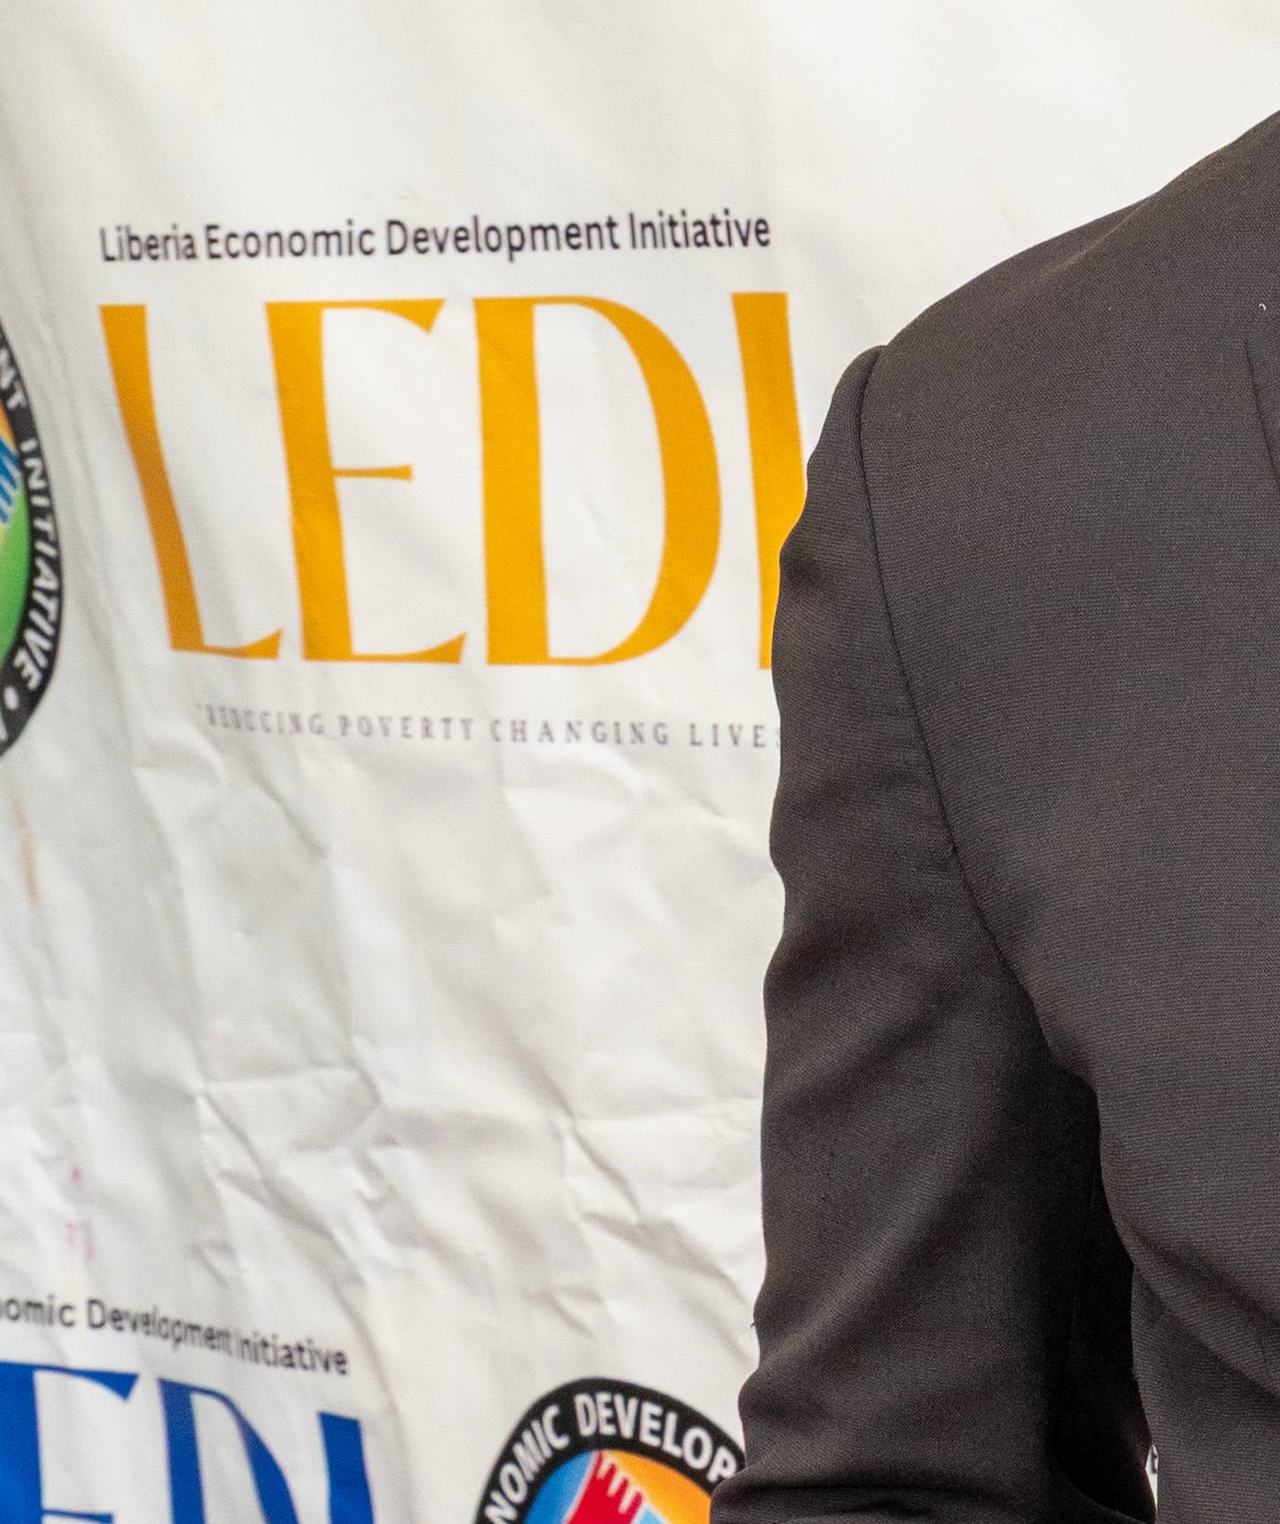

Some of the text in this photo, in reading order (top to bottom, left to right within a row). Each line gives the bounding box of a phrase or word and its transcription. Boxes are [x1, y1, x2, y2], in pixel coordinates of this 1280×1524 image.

[98, 209, 771, 264] Liberia Economic Development Initiative
[98, 291, 807, 670] LEDI
[13, 438, 59, 689] INITIATIVE
[339, 715, 475, 741] POVERTY
[491, 717, 669, 745] CHANGING
[689, 722, 780, 749] LIVE
[0, 1293, 75, 1329] omic
[87, 1298, 236, 1357] Development
